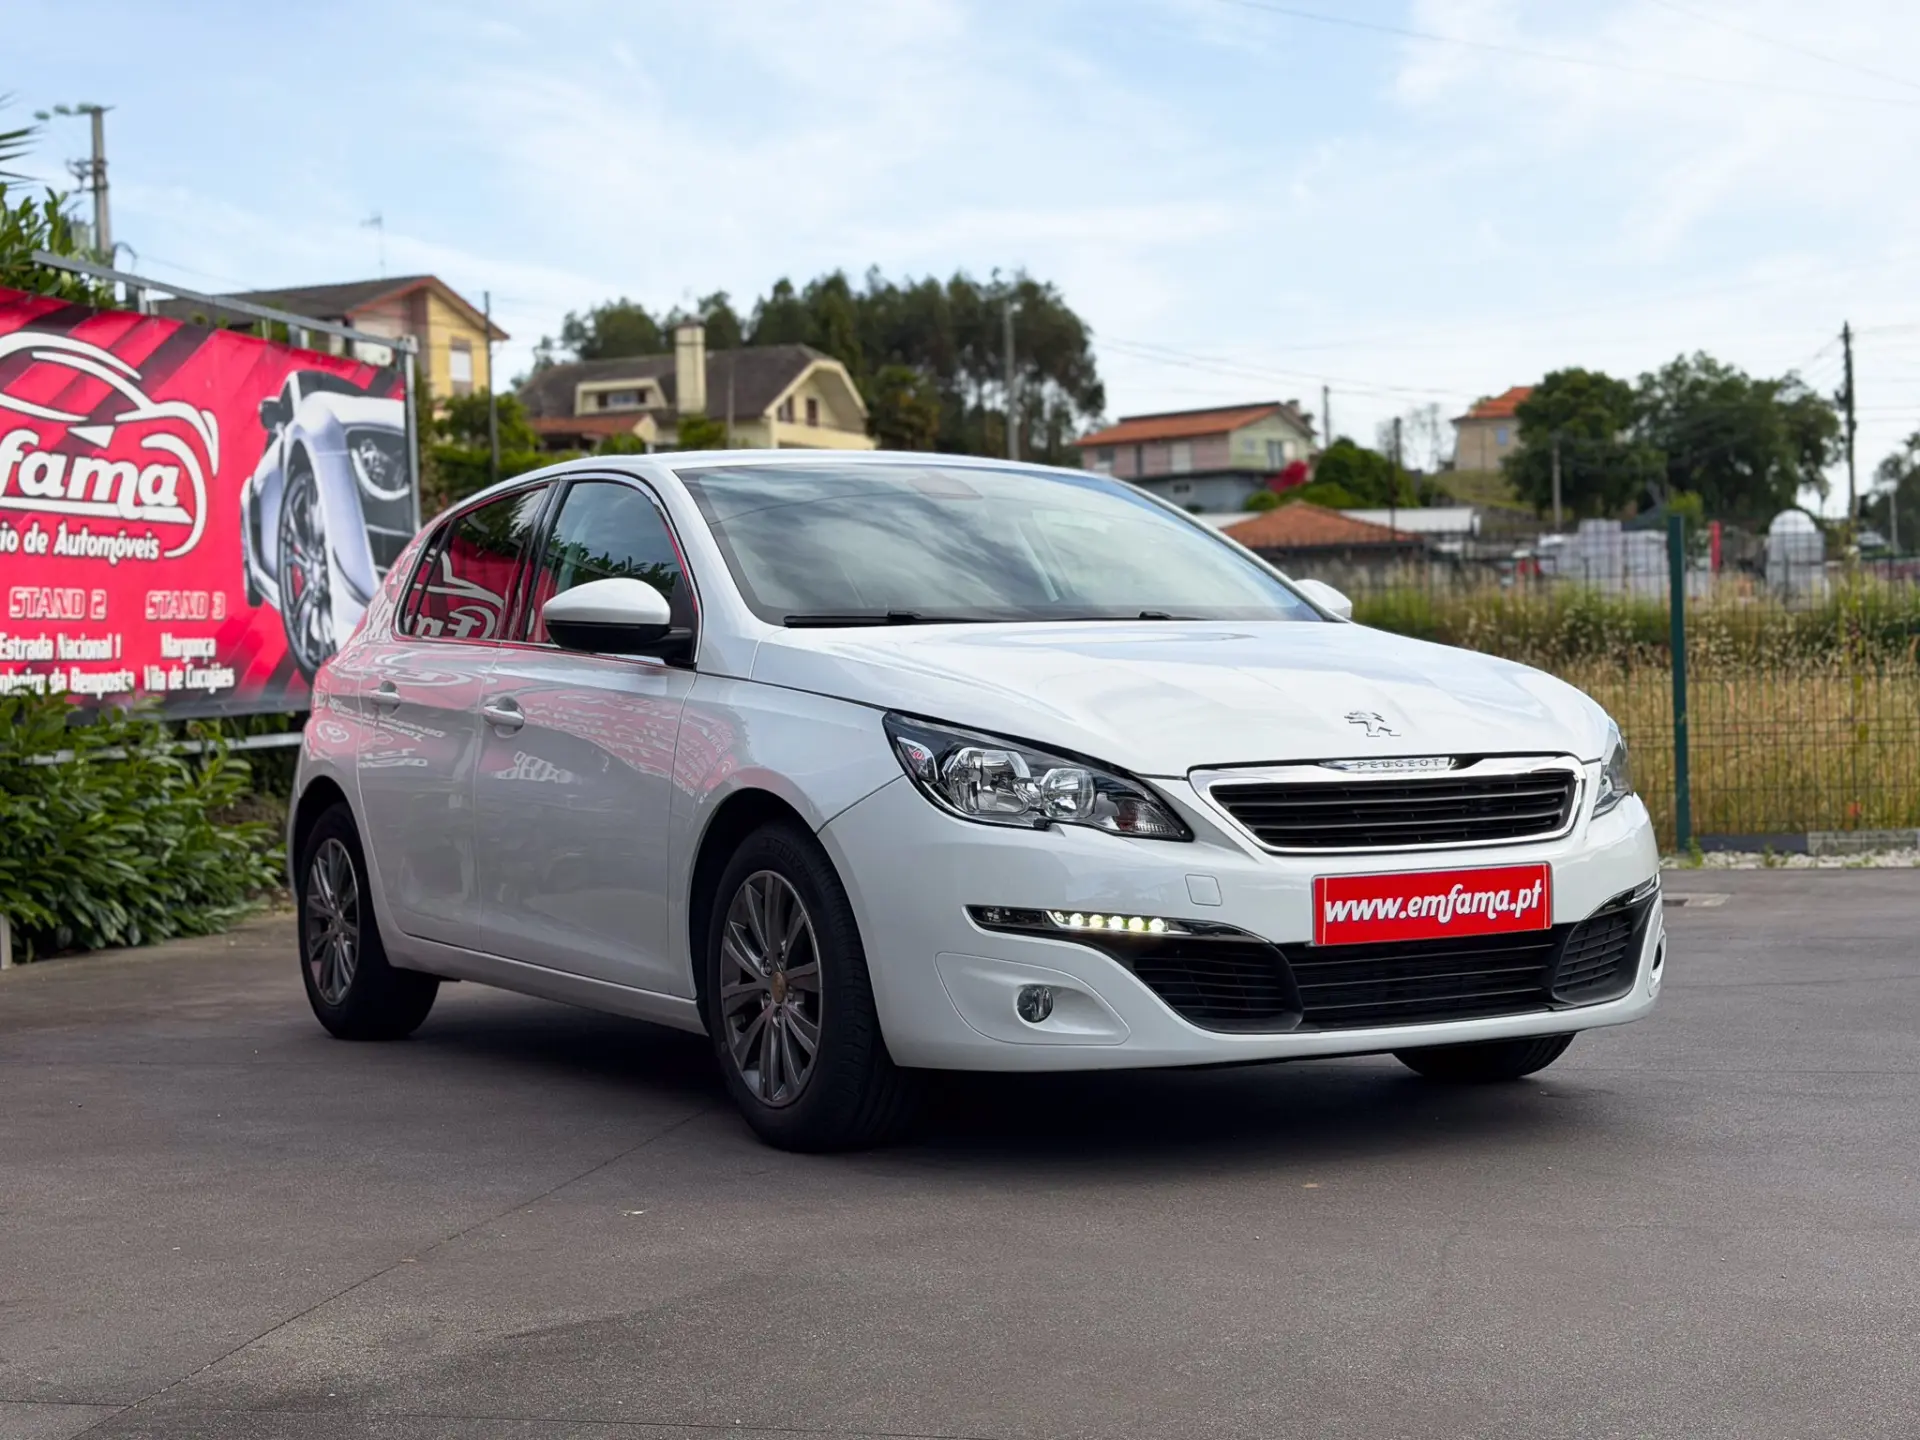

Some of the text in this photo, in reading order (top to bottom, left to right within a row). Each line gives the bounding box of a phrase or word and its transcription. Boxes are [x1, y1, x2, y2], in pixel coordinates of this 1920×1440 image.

[0, 429, 179, 519] fama
[24, 521, 48, 554] de
[54, 521, 159, 565] Automóveis
[9, 586, 107, 619] STAND 2
[145, 590, 226, 620] STAND 3
[0, 632, 54, 660] Estrada
[57, 632, 113, 660] Nacional
[144, 664, 166, 691] Vila
[168, 664, 184, 690] de
[1357, 758, 1440, 769] PEUGEOT
[1325, 879, 1542, 924] www.emfama.pt
